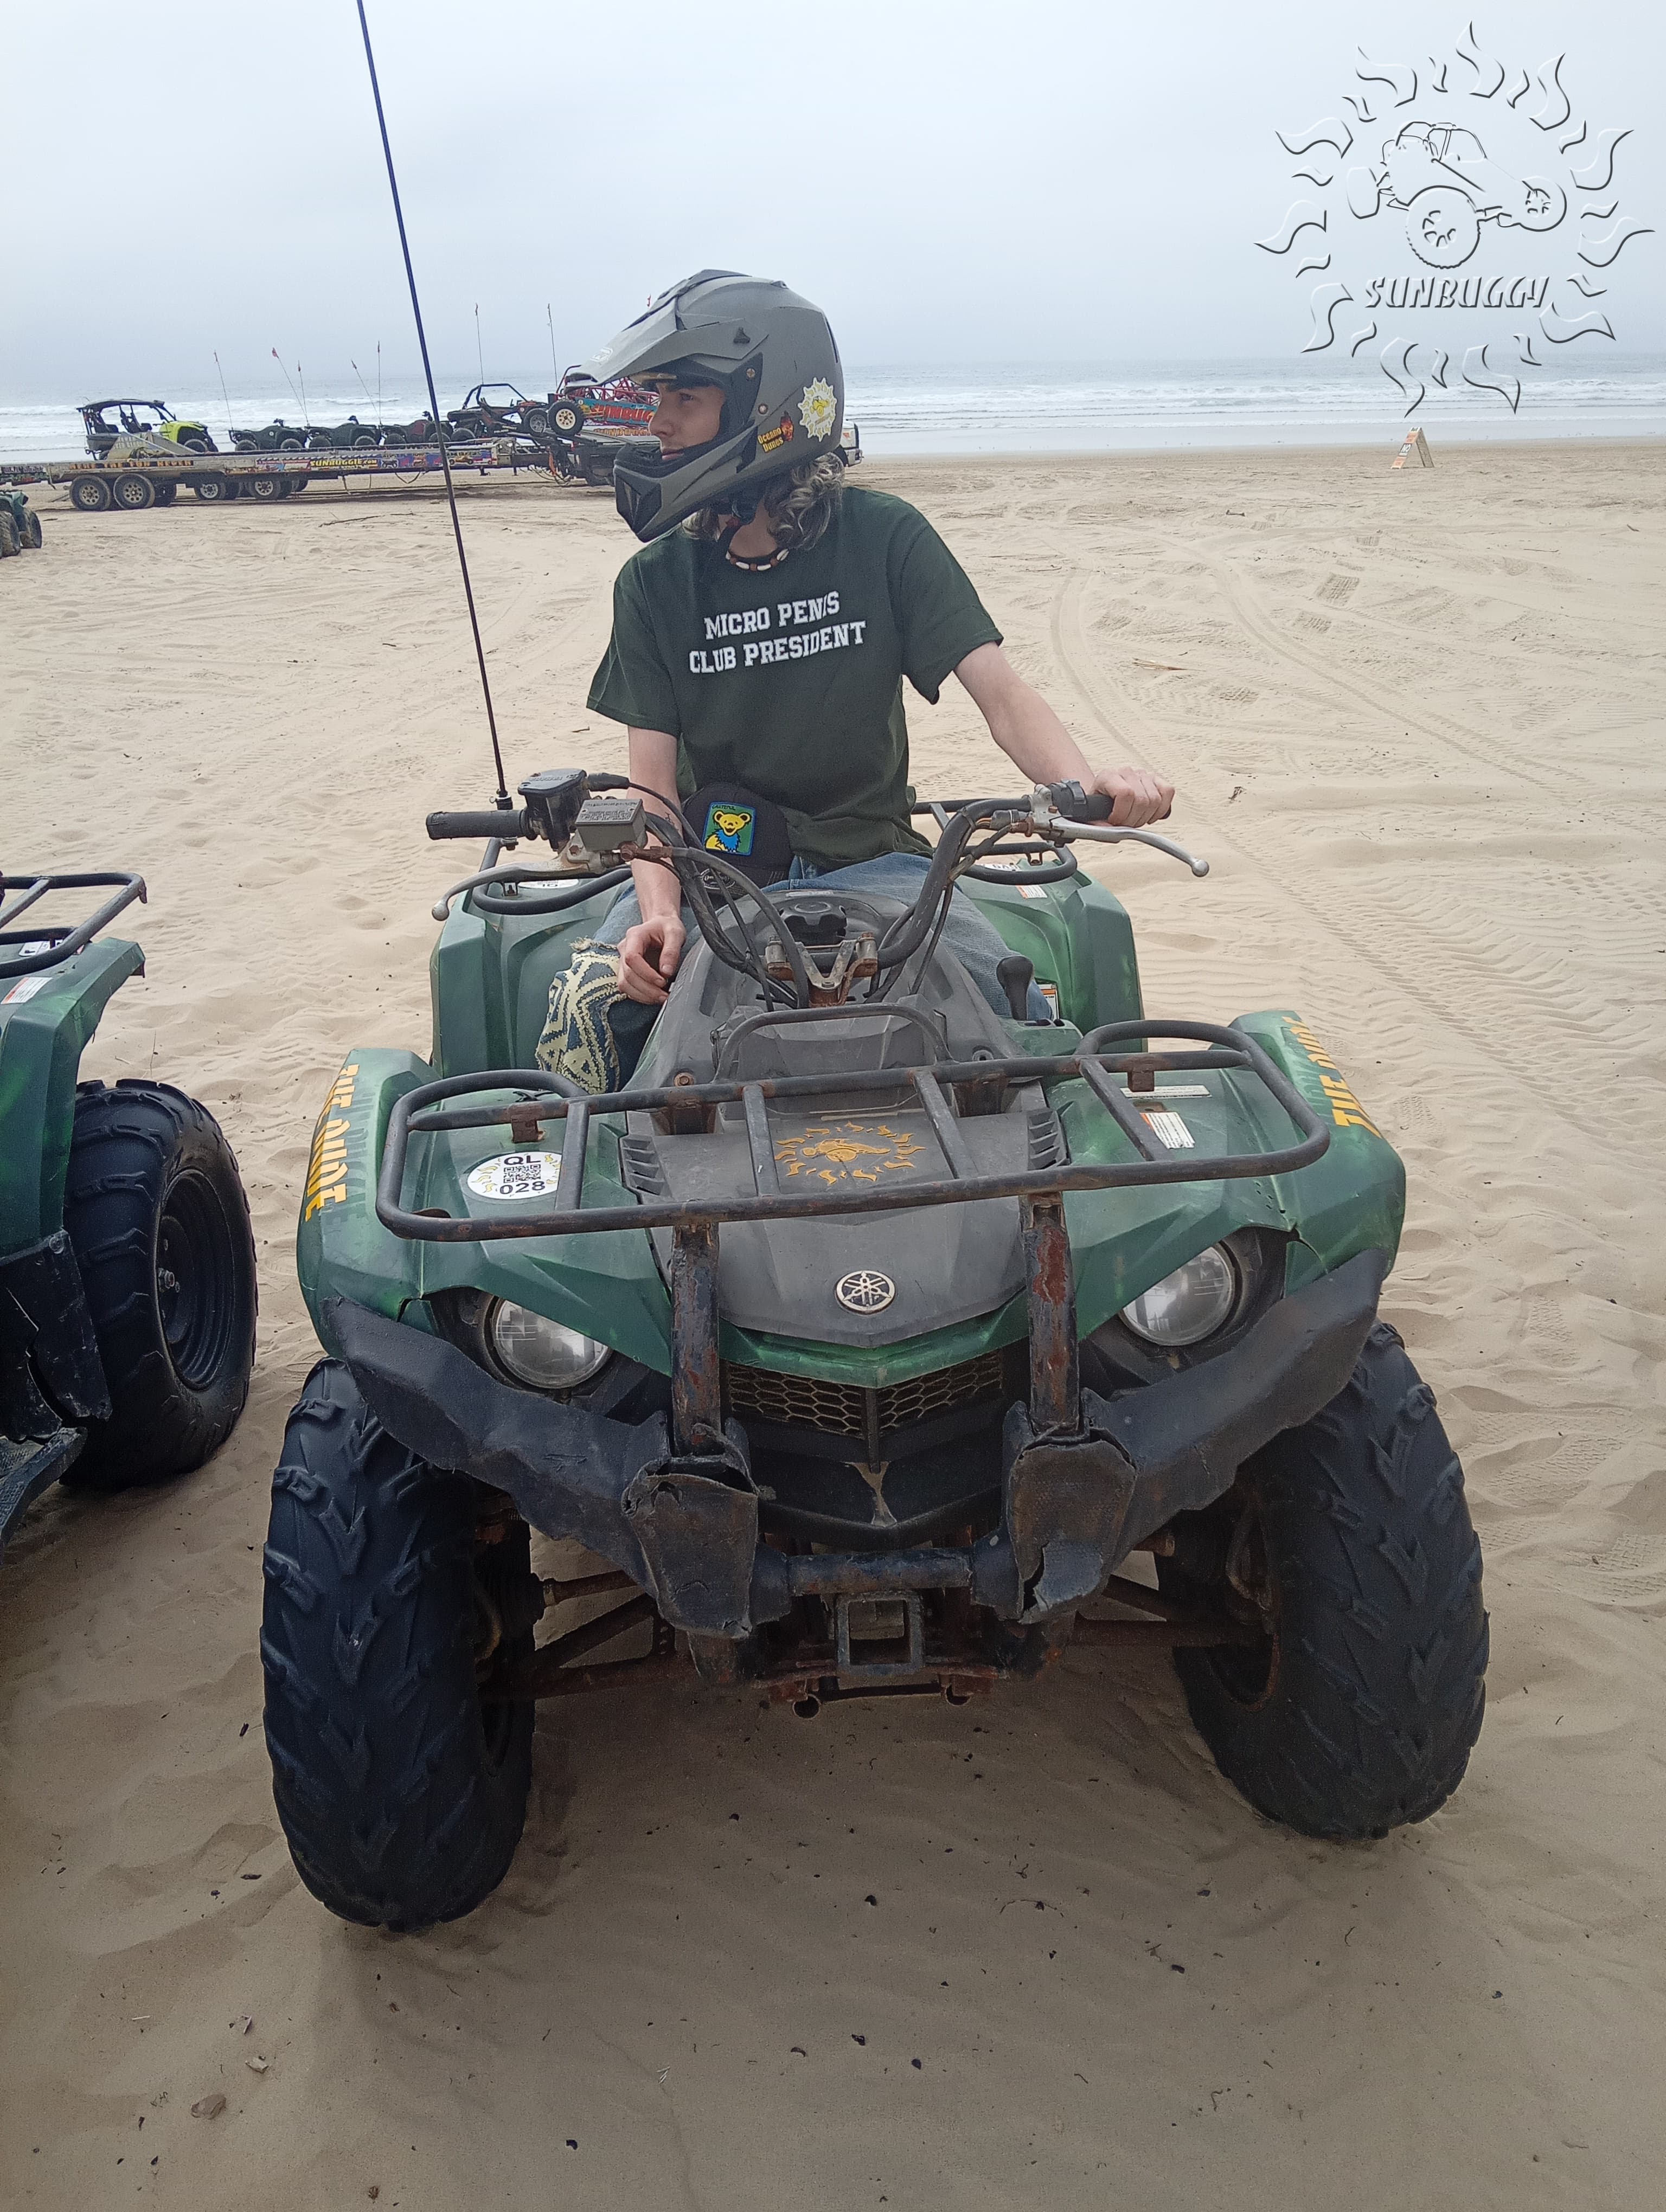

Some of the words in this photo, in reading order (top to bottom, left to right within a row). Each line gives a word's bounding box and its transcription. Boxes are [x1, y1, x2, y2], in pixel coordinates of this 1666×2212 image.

[757, 427, 782, 444] Oceano
[762, 436, 784, 453] Dunes
[1400, 443, 1412, 453] NO
[704, 607, 771, 640] MICRO
[689, 646, 737, 674] CLUB
[742, 620, 867, 667] PRESIDENT
[504, 1155, 541, 1166] QL
[499, 1181, 546, 1195] 028
